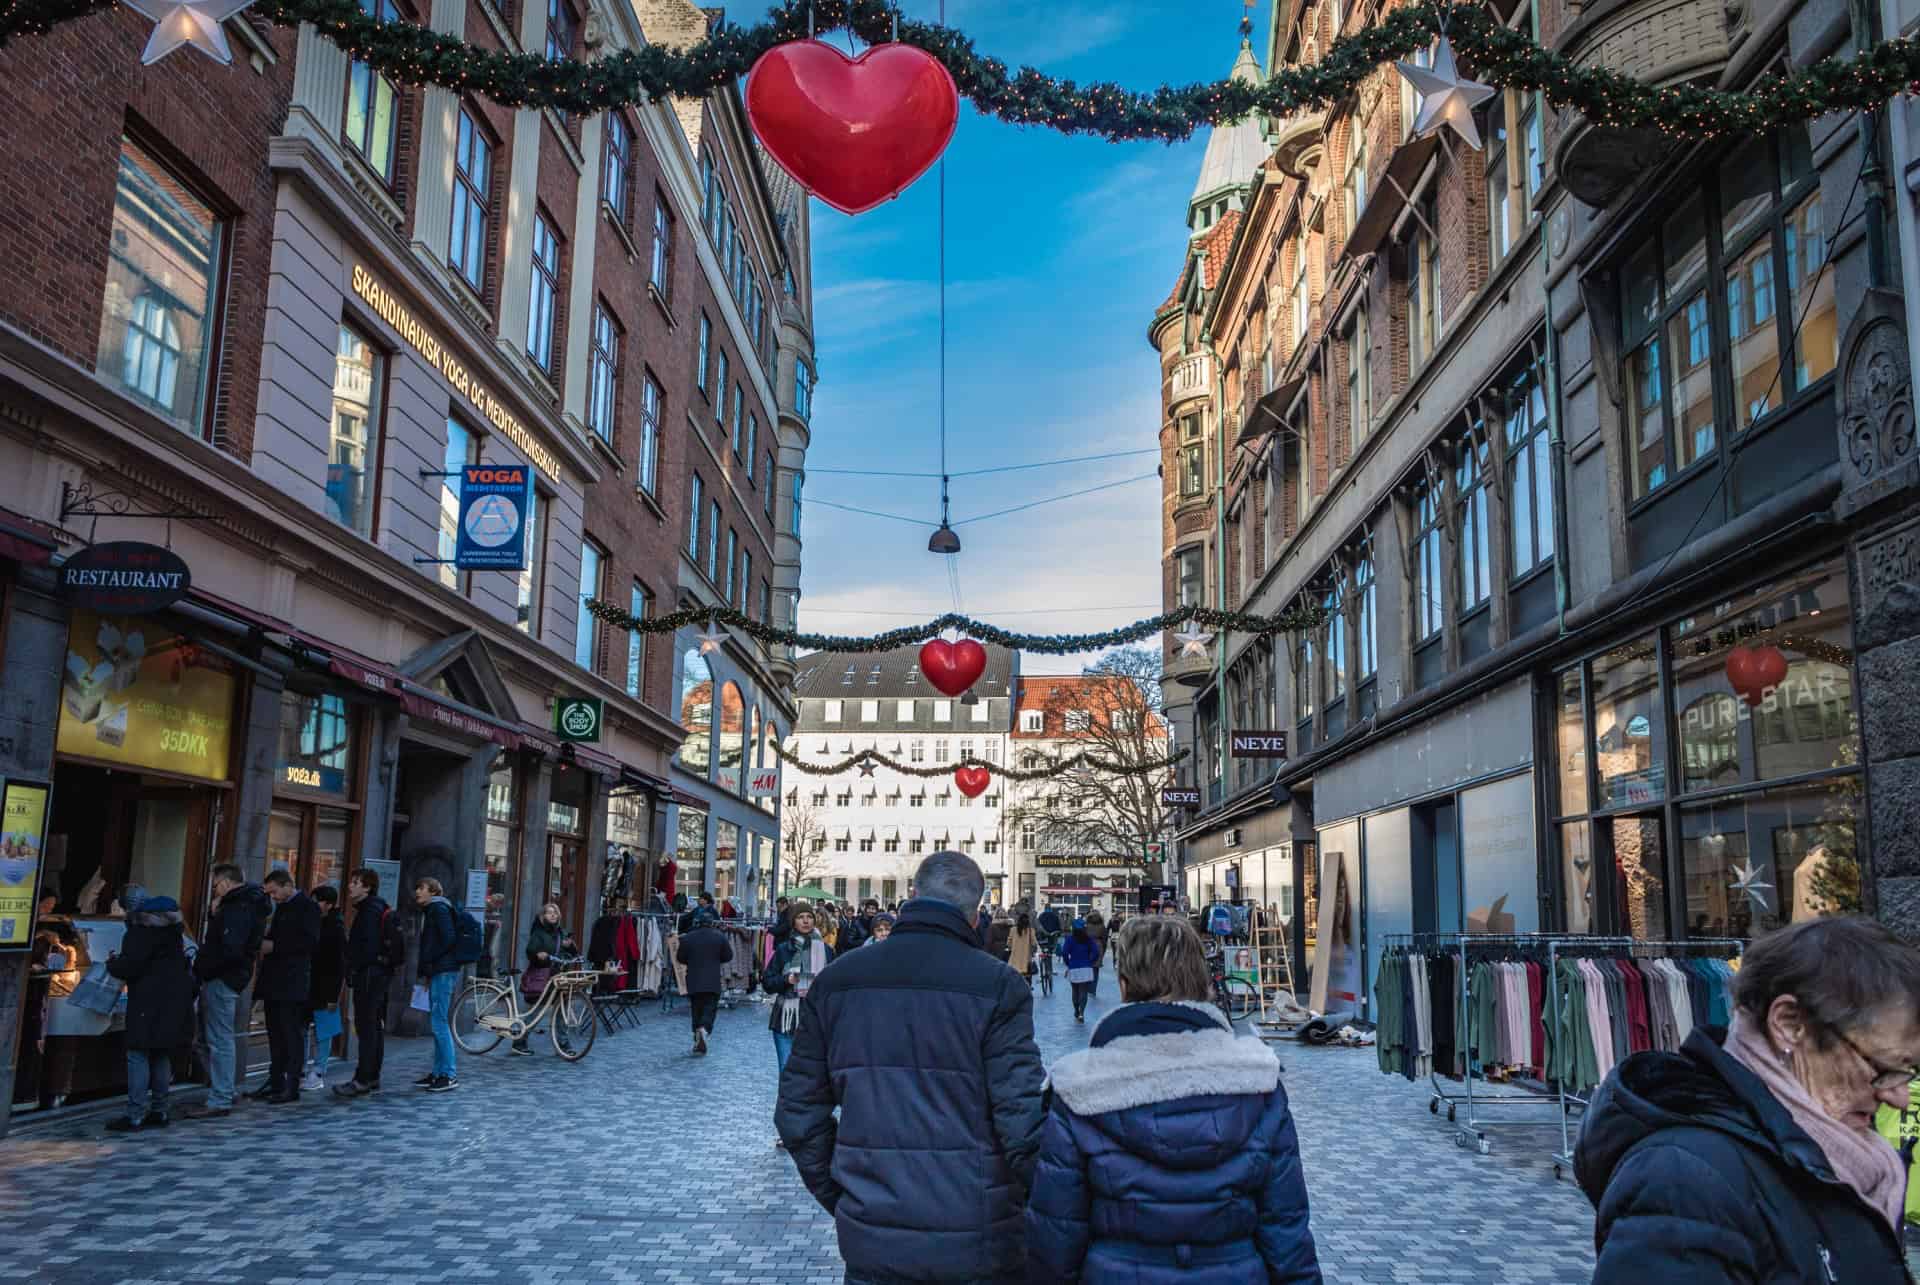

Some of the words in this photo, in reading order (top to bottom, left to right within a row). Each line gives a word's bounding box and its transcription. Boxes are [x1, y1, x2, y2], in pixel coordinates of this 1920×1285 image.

[352, 264, 441, 369] SKANDINAVISK
[442, 351, 469, 397] YOGA
[471, 382, 485, 410] OG
[485, 399, 561, 484] MEDITATIONSSKOLE
[467, 470, 523, 483] YOGA
[66, 568, 183, 589] RESTAURANT
[1686, 693, 1750, 733] PURE
[1761, 670, 1836, 714] STAR
[160, 728, 209, 757] 35DKK
[1233, 737, 1284, 750] NEYE
[287, 766, 321, 787] yoga.dk
[1163, 792, 1199, 802] NEYE
